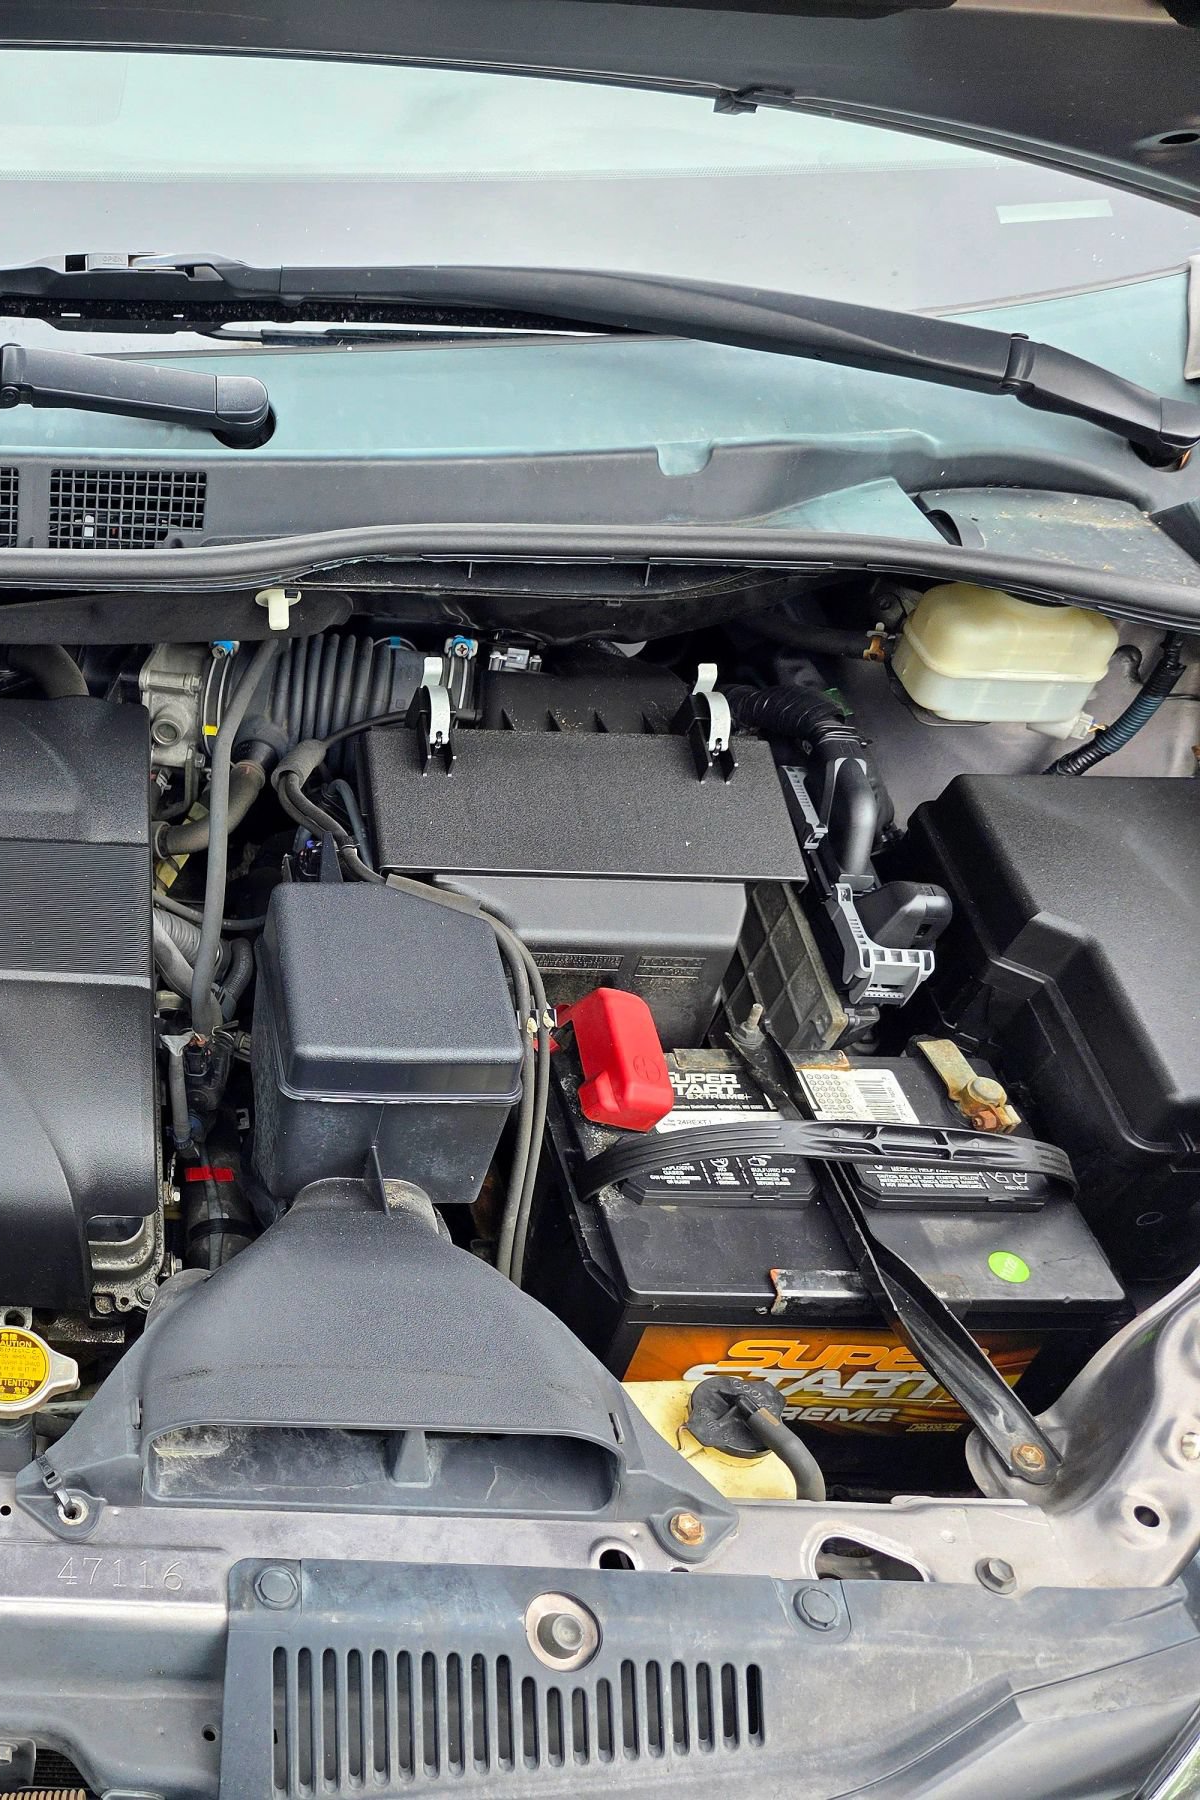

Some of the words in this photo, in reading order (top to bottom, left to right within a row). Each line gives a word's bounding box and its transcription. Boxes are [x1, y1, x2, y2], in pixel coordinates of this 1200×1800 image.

[672, 1084, 741, 1096] TART
[716, 1340, 927, 1371] SUPE
[780, 1408, 899, 1423] REME
[57, 1557, 184, 1591] 47116
